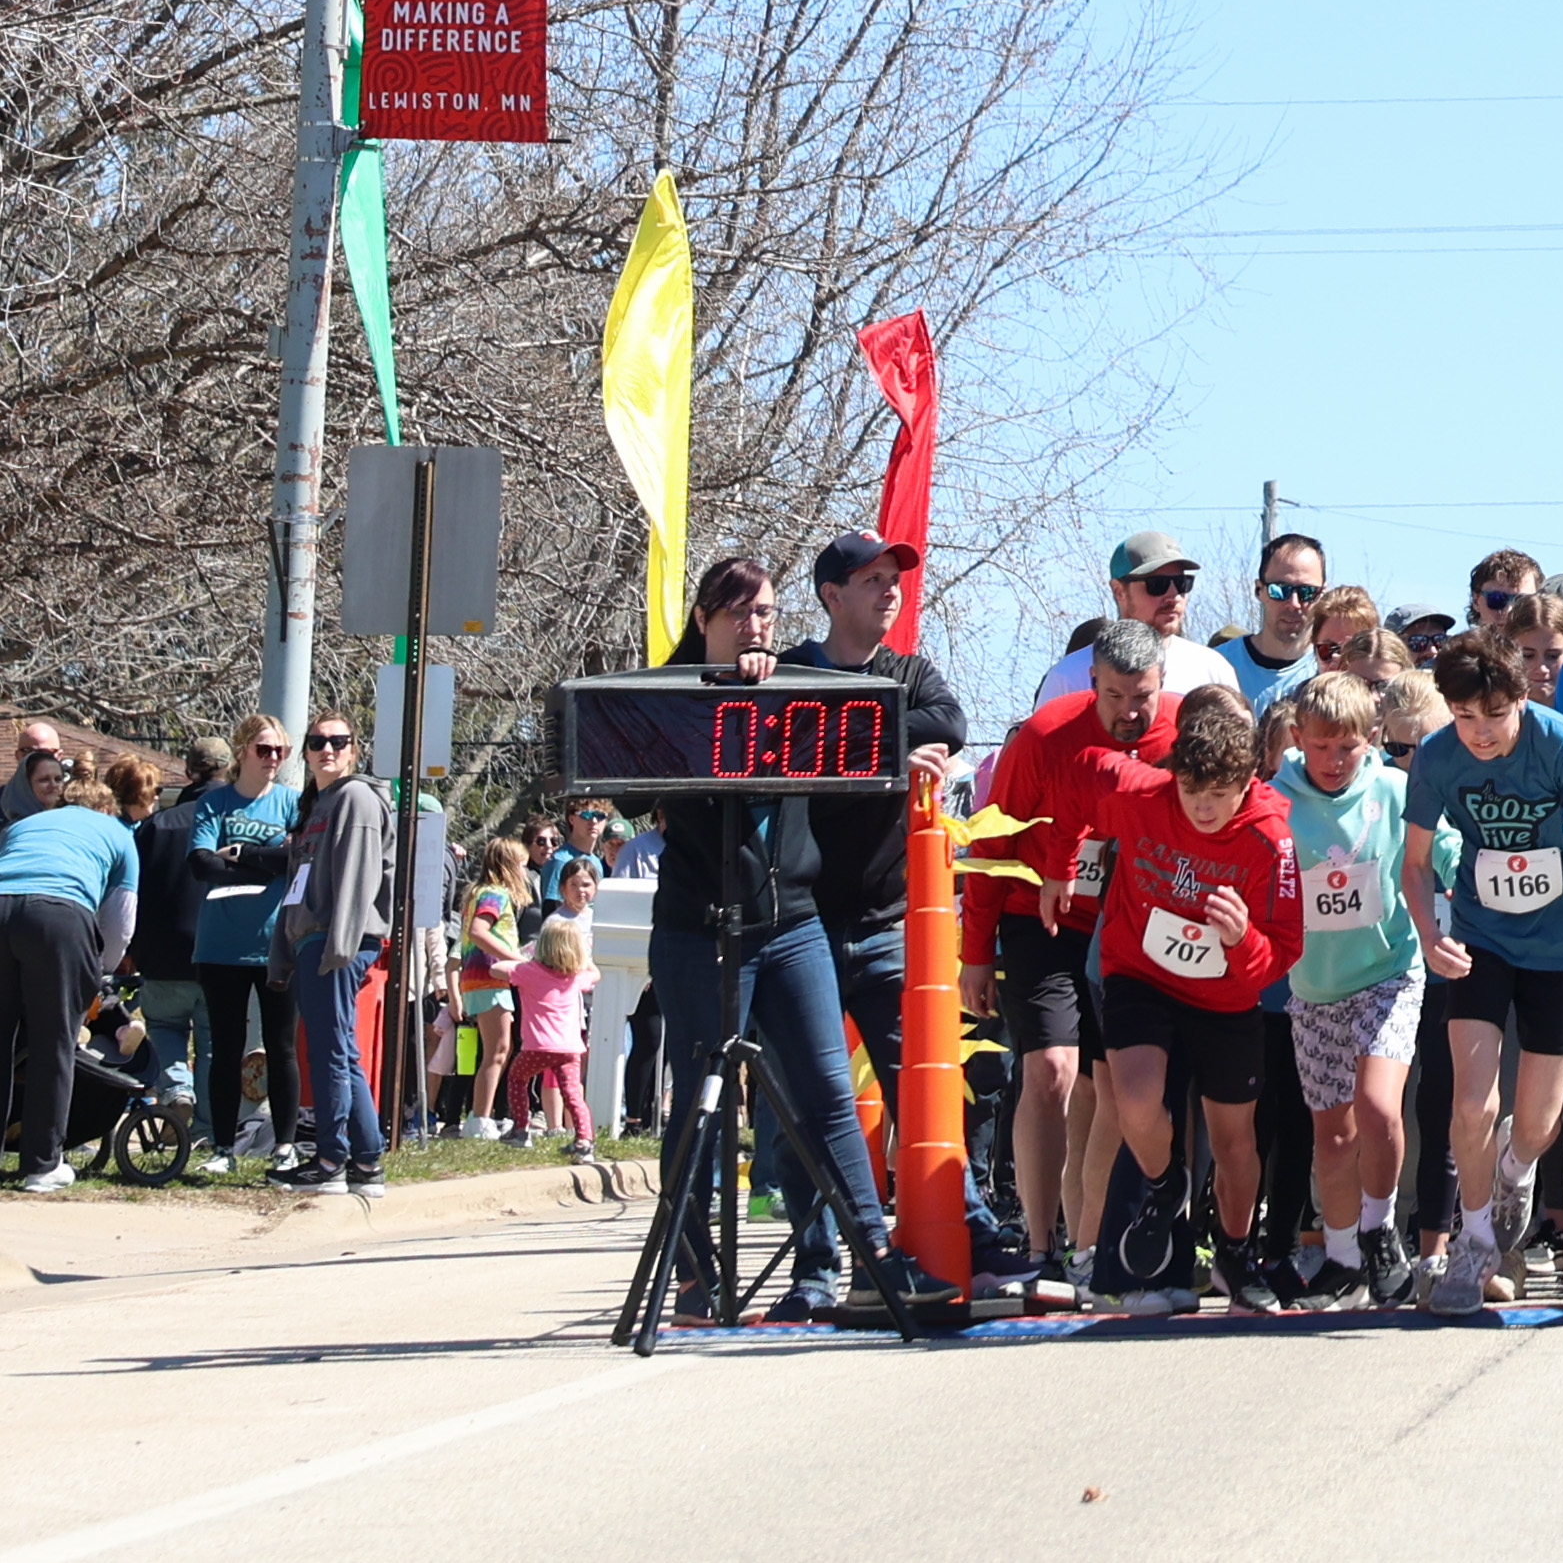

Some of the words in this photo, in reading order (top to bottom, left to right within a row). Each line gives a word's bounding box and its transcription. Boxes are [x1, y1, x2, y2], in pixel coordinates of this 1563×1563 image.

[393, 1, 485, 25] MAKING
[494, 3, 510, 26] A
[381, 29, 522, 54] DIFFERENCE
[501, 94, 532, 112] MN
[712, 701, 881, 777] 0:00
[1465, 794, 1556, 821] FOOLS
[225, 817, 282, 841] FOOLS
[1278, 837, 1296, 899] SPELTZ
[1489, 874, 1550, 897] 1166
[1317, 889, 1362, 915] 654
[1164, 936, 1210, 965] 707
